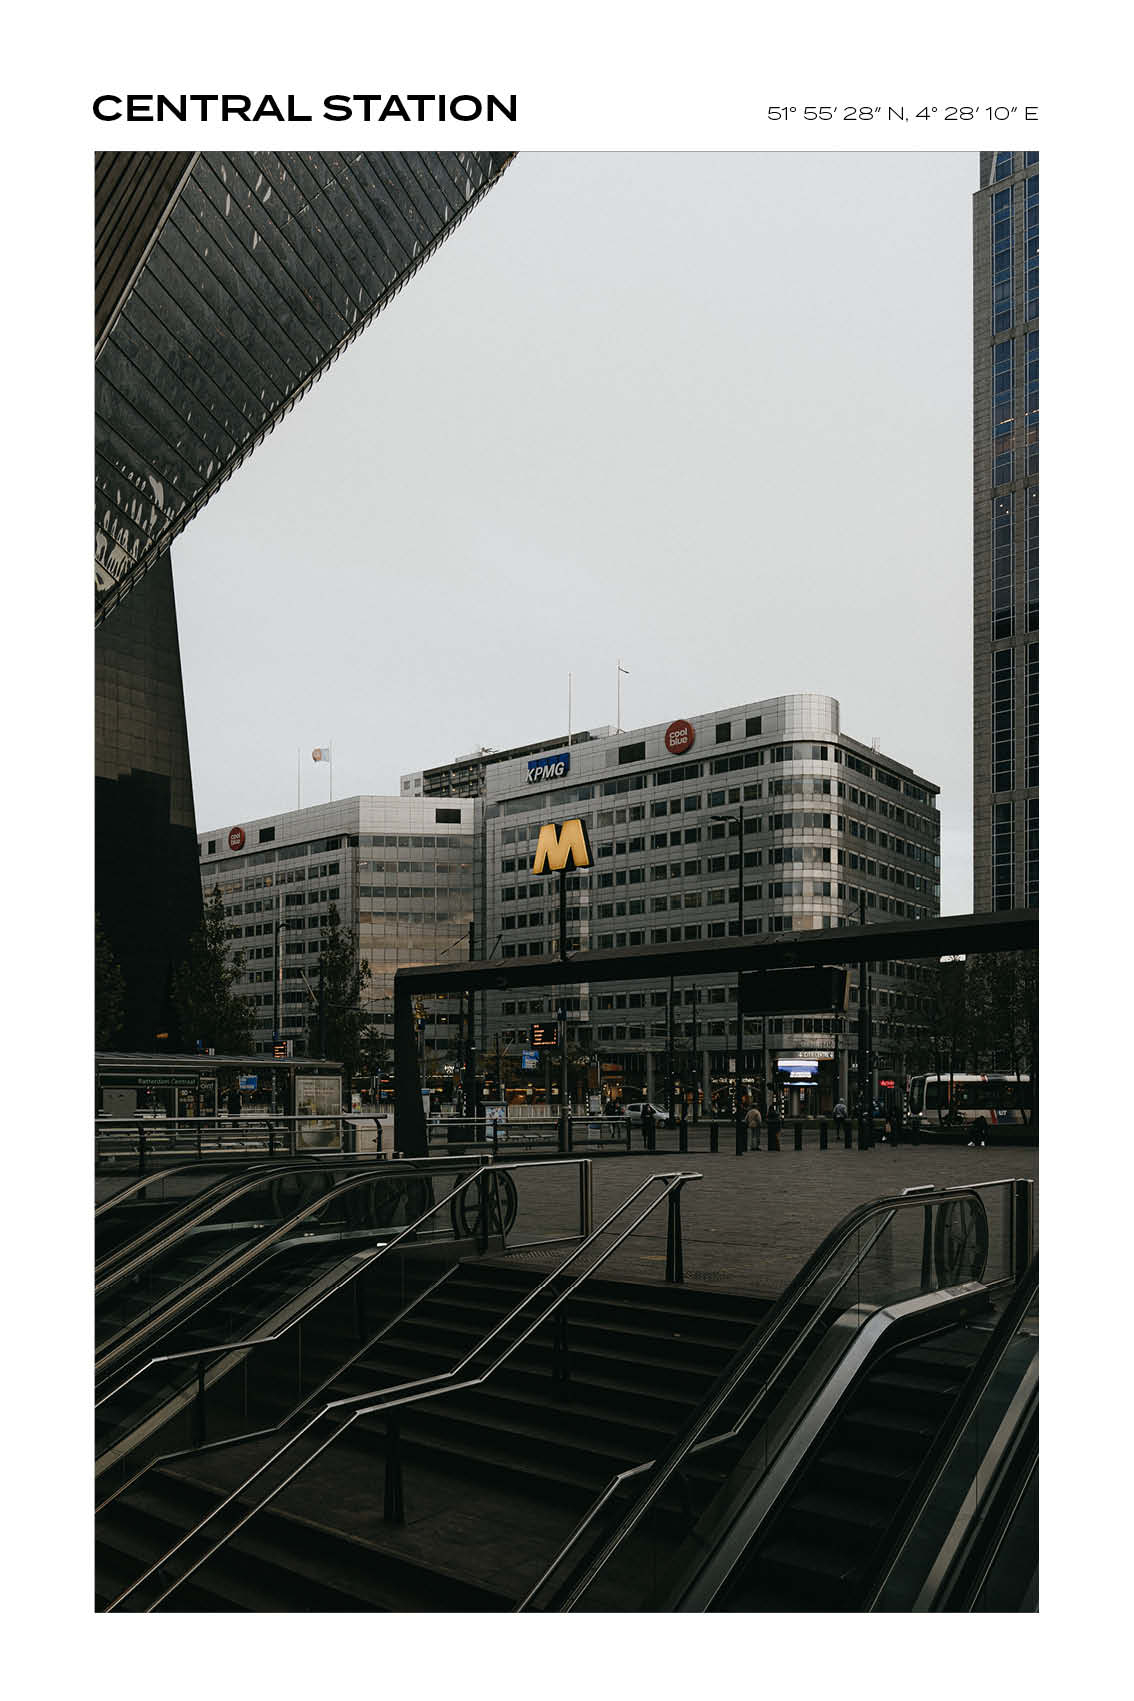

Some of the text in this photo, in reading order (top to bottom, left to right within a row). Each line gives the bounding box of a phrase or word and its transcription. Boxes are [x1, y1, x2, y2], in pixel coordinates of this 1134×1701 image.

[670, 728, 688, 738] cool
[670, 737, 688, 746] blue
[525, 761, 565, 782] KPMG
[531, 818, 592, 876] M
